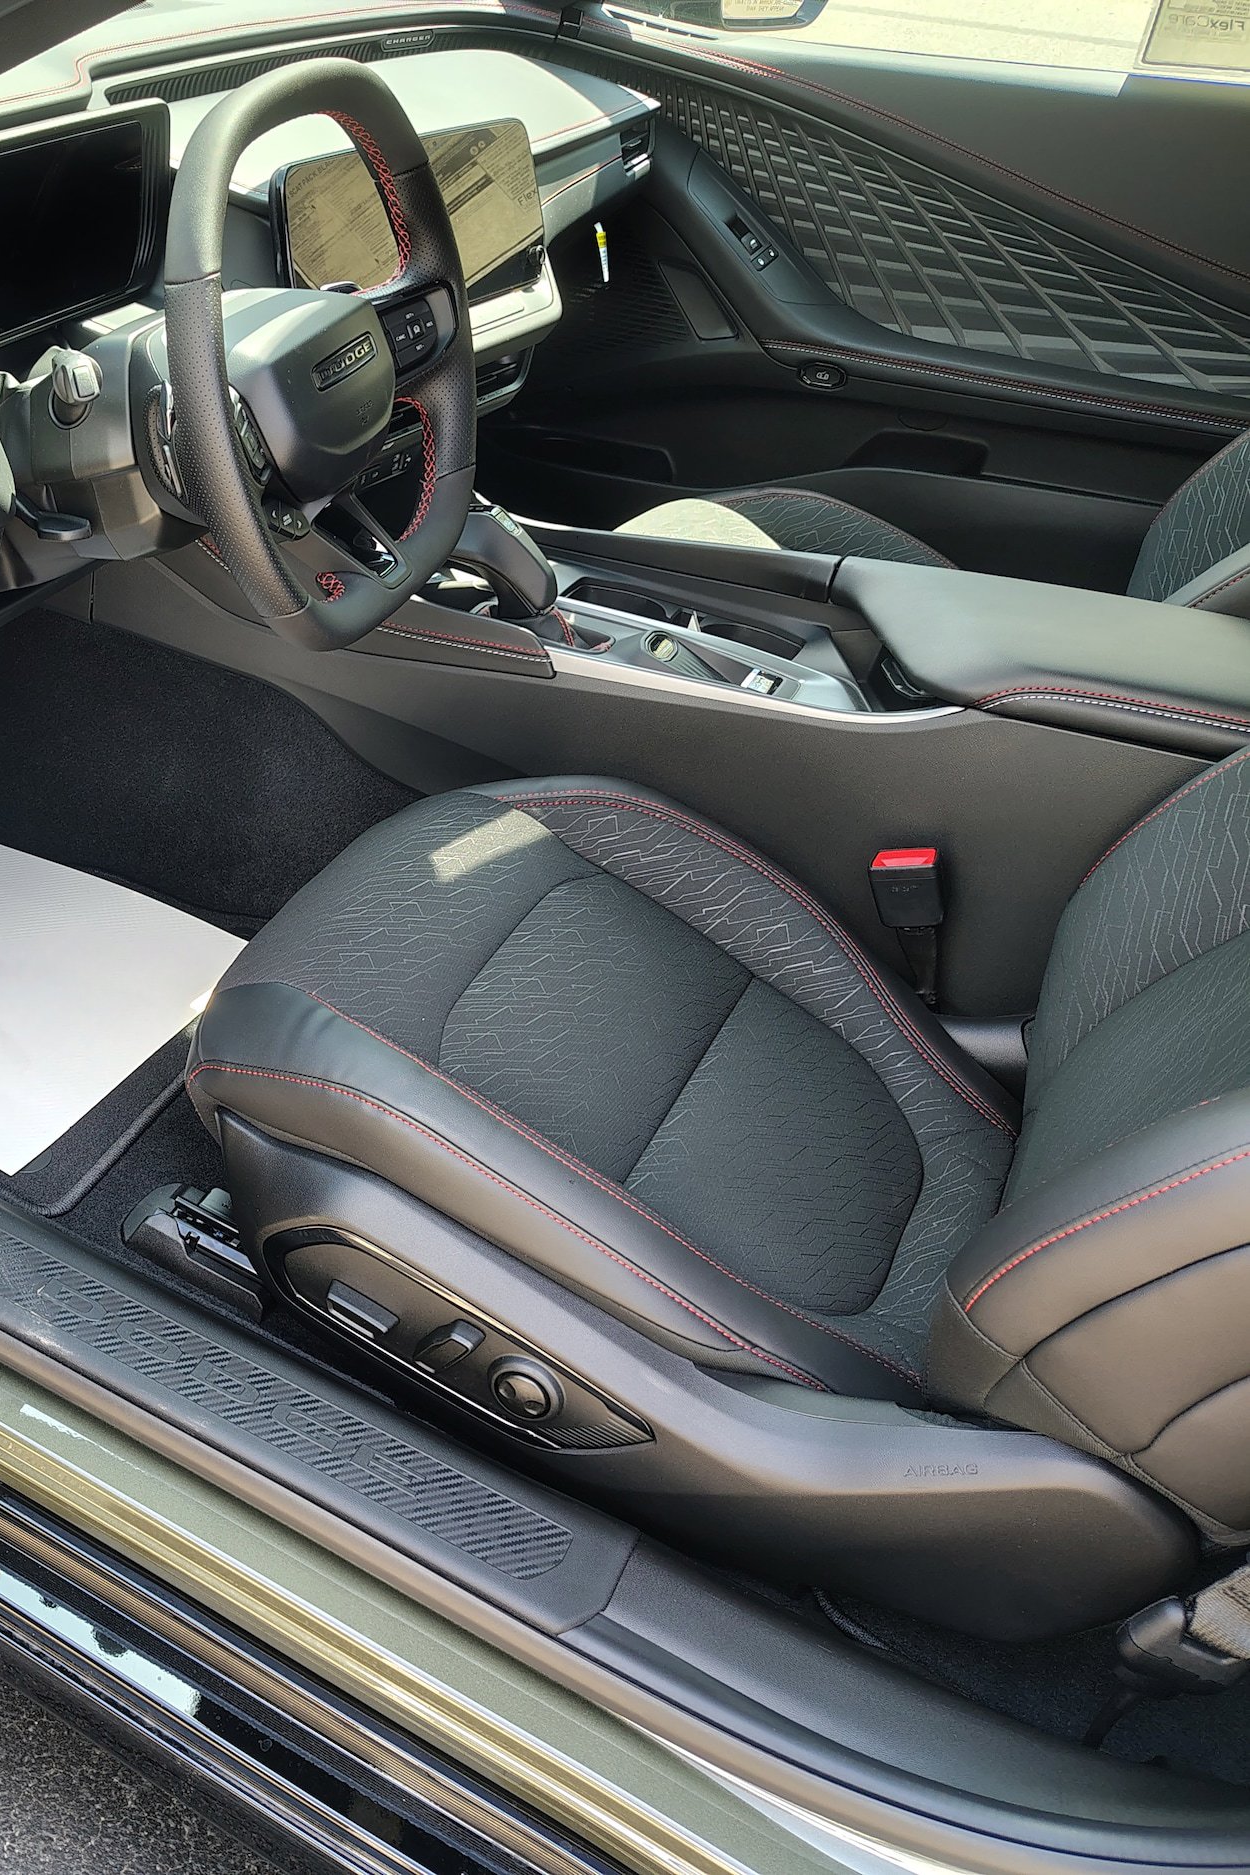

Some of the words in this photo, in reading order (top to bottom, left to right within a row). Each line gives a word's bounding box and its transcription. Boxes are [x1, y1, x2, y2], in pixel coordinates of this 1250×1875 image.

[317, 339, 373, 384] DODGE
[36, 1278, 427, 1499] DODGE
[903, 1463, 979, 1478] AIRBAG
